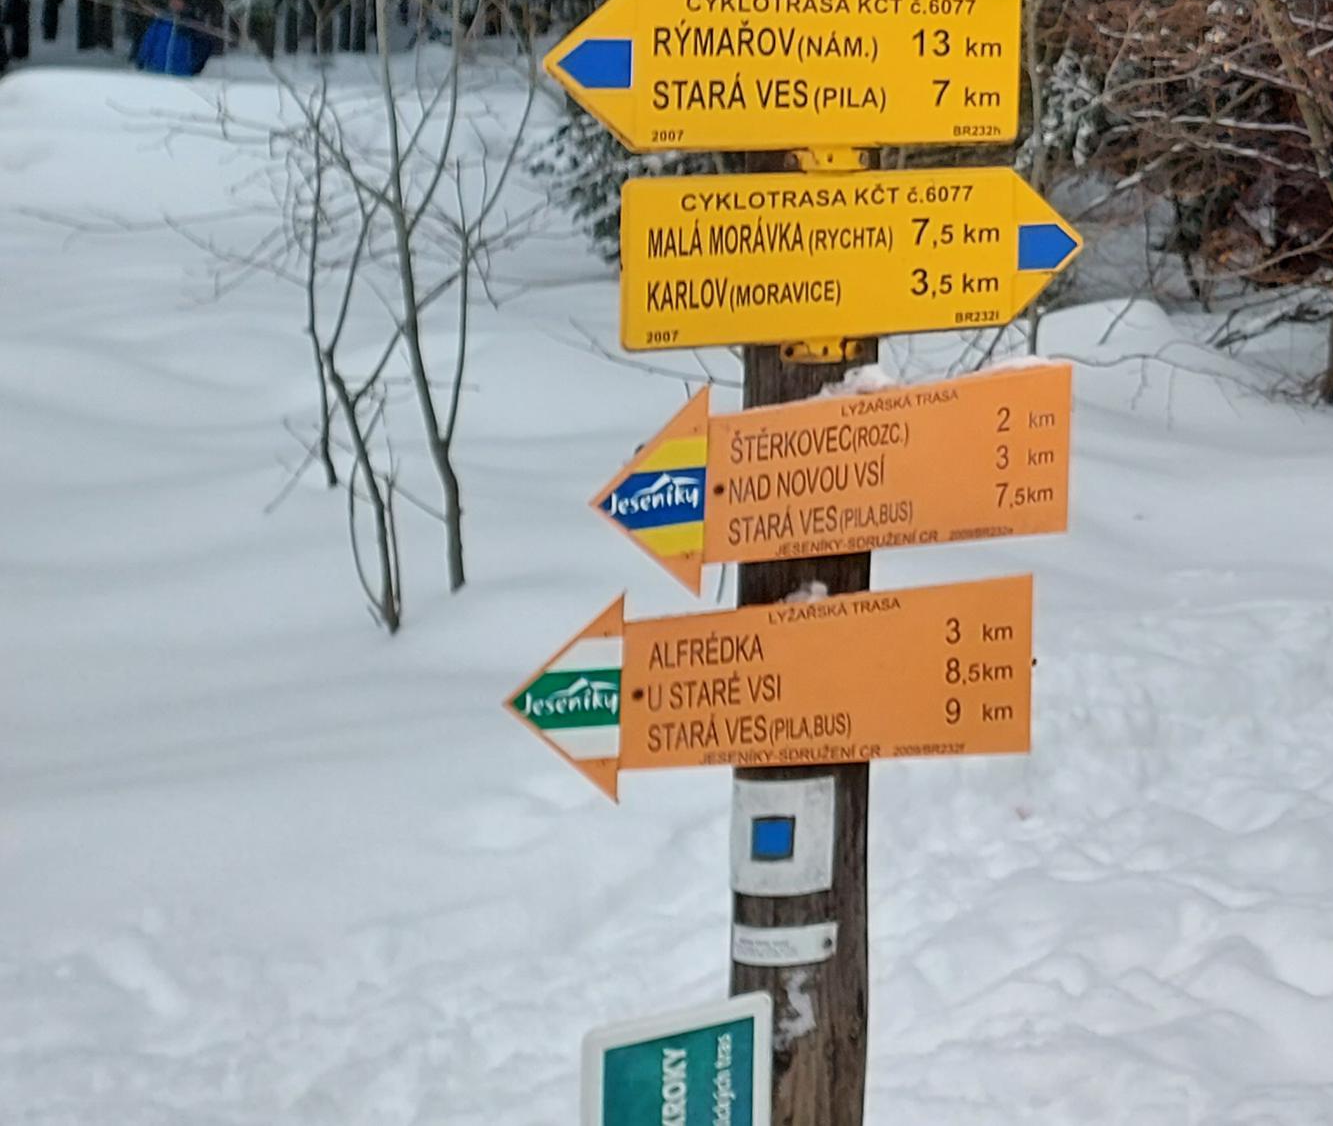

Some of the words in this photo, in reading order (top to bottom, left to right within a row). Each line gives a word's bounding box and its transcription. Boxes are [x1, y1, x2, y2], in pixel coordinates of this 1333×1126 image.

[911, 30, 951, 57] 13
[965, 38, 1002, 58] km
[652, 73, 745, 110] STARÁ
[932, 80, 950, 107] 7
[964, 88, 1000, 107] km
[652, 130, 684, 142] 2007
[681, 189, 847, 213] CYKLOTRASA
[854, 183, 900, 206] KČT
[907, 185, 974, 205] č.6077
[647, 220, 703, 259] MALÁ
[911, 218, 954, 250] 7,5
[963, 224, 999, 243] km
[910, 268, 953, 299] 3,5
[962, 273, 999, 293] km
[646, 331, 679, 344] 2007
[916, 389, 959, 407] TRASA
[996, 408, 1010, 432] 2
[1028, 411, 1055, 430] km
[728, 478, 770, 506] NAD
[776, 464, 850, 498] NOVOU
[854, 454, 885, 486] VSÍ
[996, 445, 1009, 470] 3
[1027, 448, 1055, 467] km
[609, 482, 699, 516] Jeseníky
[728, 505, 794, 547] STARÁ
[852, 598, 901, 617] TRASA
[649, 631, 764, 672] ALFRÉDKA
[945, 619, 961, 645] 3
[982, 621, 1013, 642] km
[518, 680, 619, 718] Jeseníky
[647, 684, 666, 711] U
[670, 675, 743, 711] STARÉ
[751, 676, 782, 701] VSI
[647, 717, 718, 754] STARÁ
[945, 698, 961, 724] 9
[982, 702, 1014, 722] km
